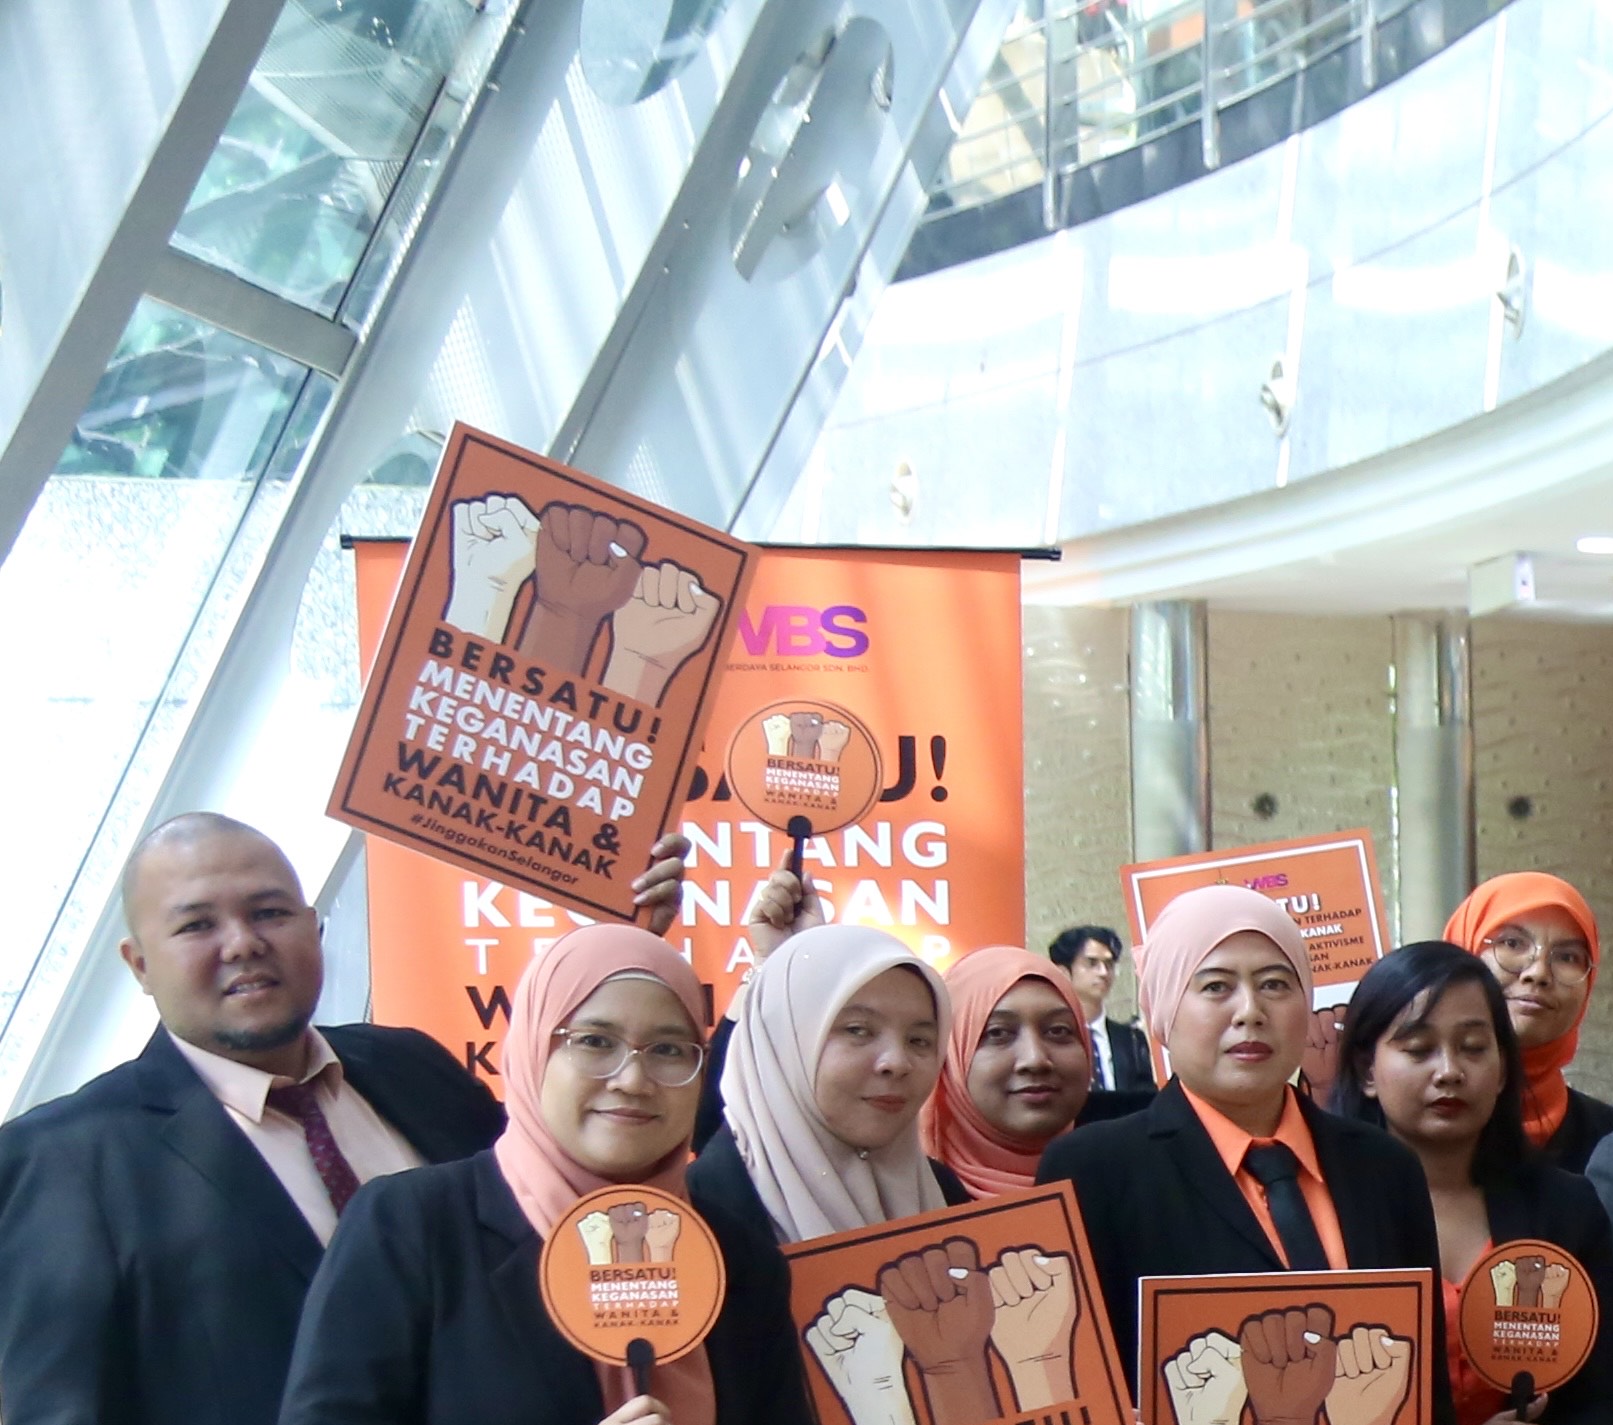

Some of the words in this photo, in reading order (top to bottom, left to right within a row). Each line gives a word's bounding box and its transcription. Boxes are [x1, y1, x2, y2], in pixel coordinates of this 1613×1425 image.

[428, 627, 661, 744] BERSATU!
[419, 660, 653, 770] MENENTANG
[409, 686, 644, 798] KEGANASAN
[404, 713, 635, 821] TERHADAP
[767, 759, 840, 775] BERSATU!
[766, 768, 839, 783] MENENTANG
[766, 776, 839, 791] KEGANASAN
[398, 741, 572, 837] WANITA
[592, 823, 620, 856] &
[383, 772, 616, 879] KANAK-KANAK
[411, 814, 579, 885] #JinggakanSelangor
[1306, 909, 1361, 924] TERHADAP
[1309, 936, 1364, 951] AKTIVISME
[590, 1268, 675, 1282] BERSATU!
[591, 1281, 677, 1292] MENENTANG
[592, 1290, 678, 1302] KEGANASAN
[594, 1300, 678, 1310] TERHADAP
[594, 1310, 659, 1319] WANITA
[1495, 1310, 1560, 1323] BERSATU!
[1494, 1322, 1559, 1332] MENENTANG
[1493, 1330, 1559, 1340] KEGANASAN
